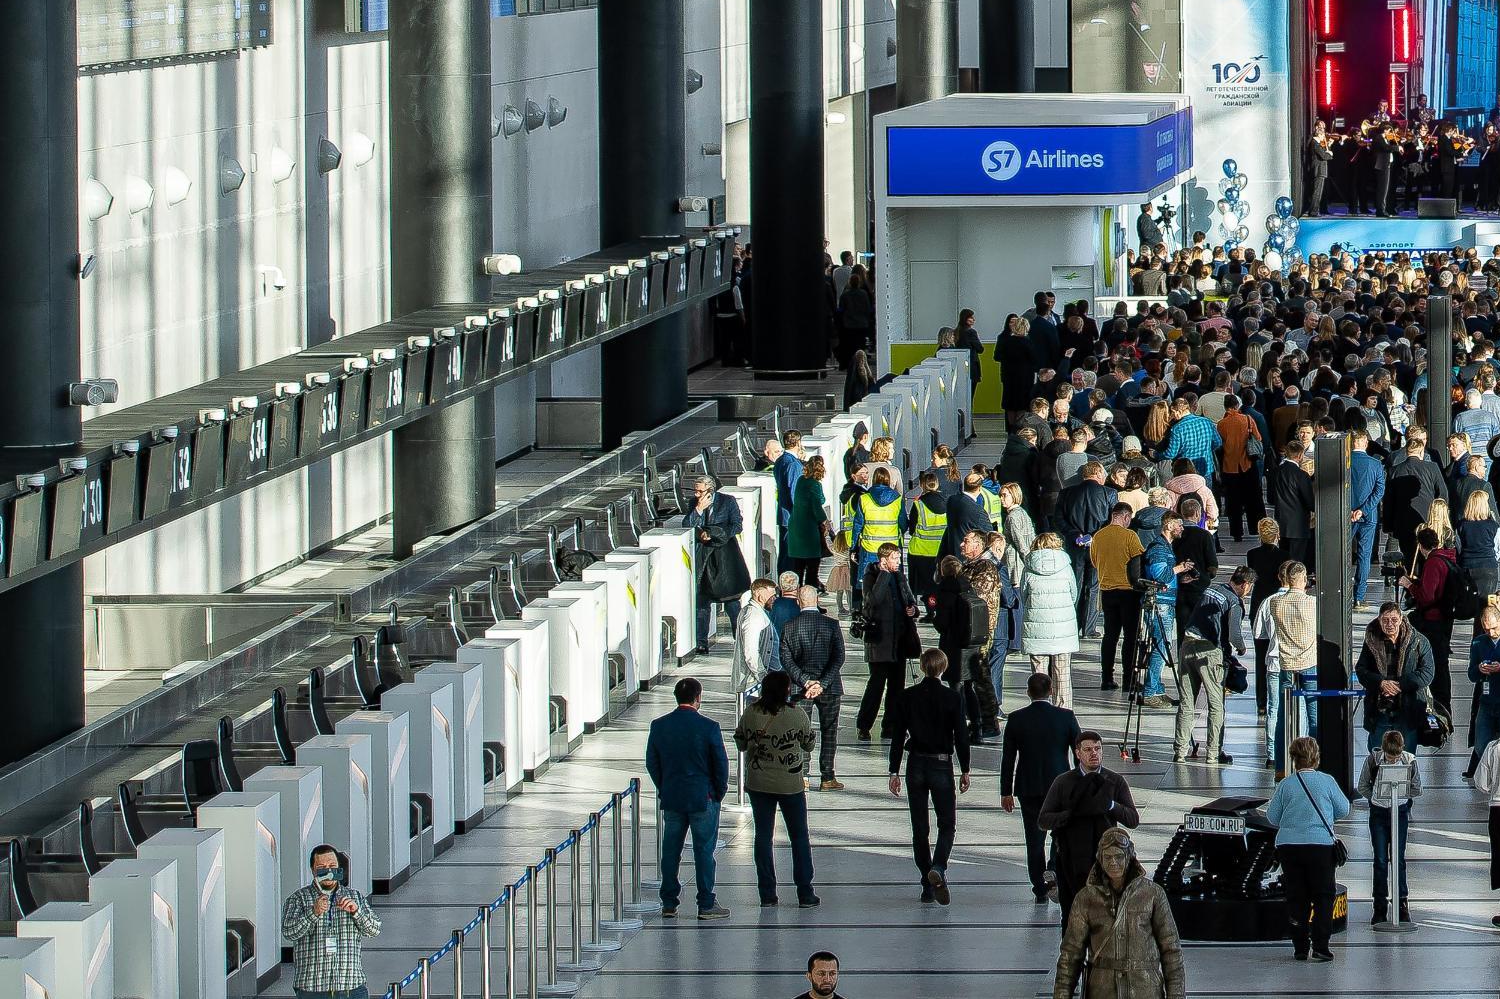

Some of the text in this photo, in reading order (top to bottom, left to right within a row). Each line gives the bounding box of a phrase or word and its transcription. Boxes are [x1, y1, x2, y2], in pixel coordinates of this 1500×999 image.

[1212, 62, 1261, 84] 100
[1026, 149, 1104, 169] Airlines
[178, 445, 190, 490] 32
[88, 478, 103, 526] 30
